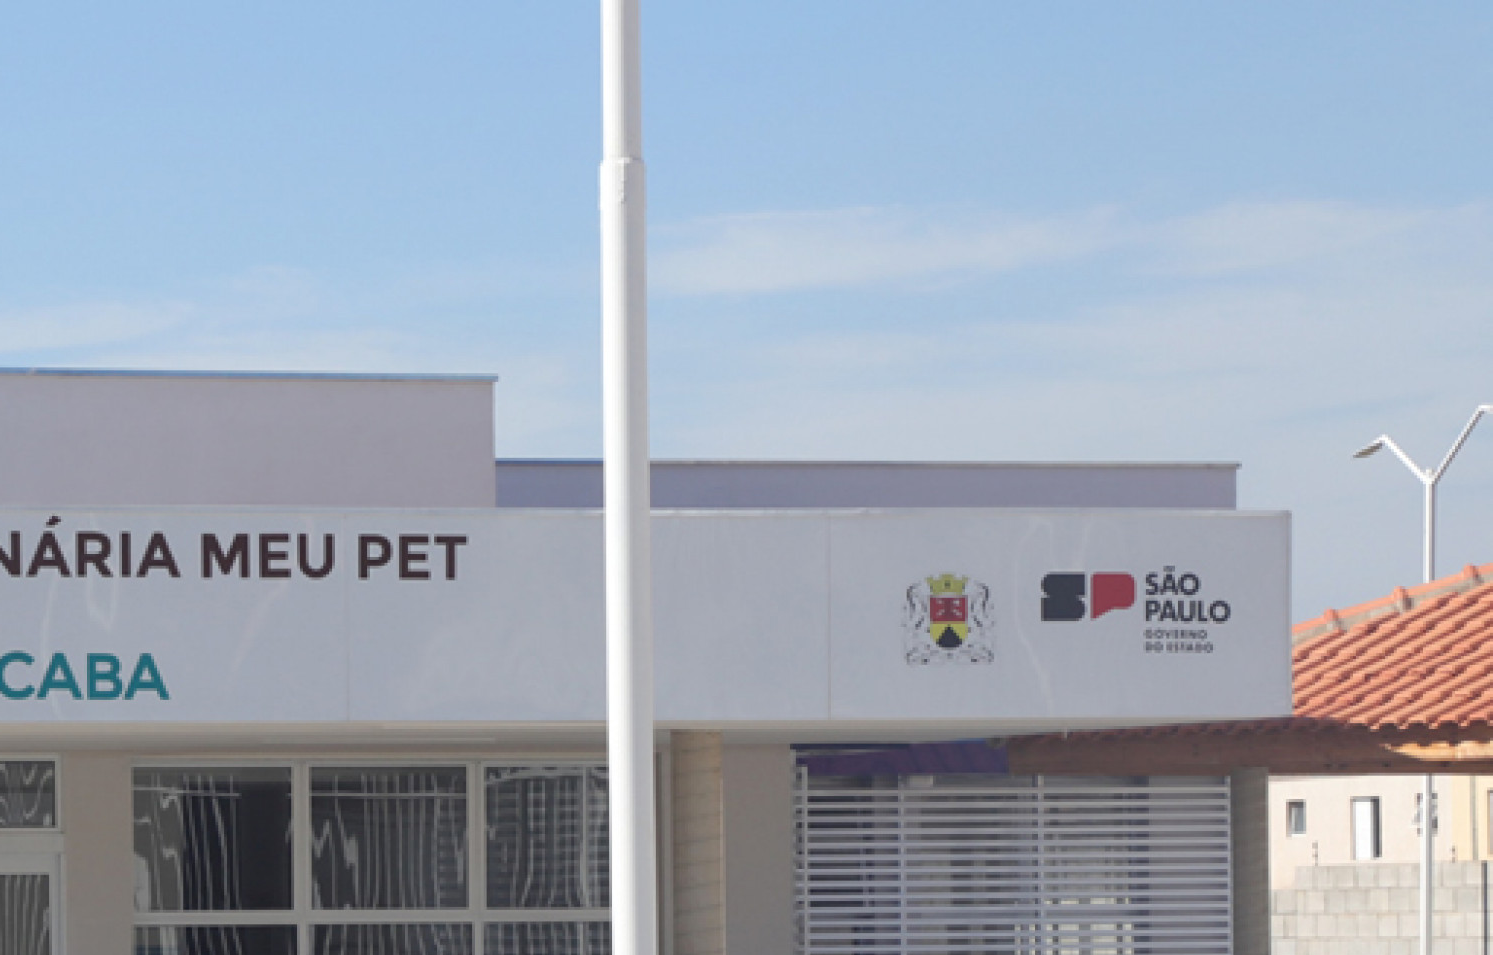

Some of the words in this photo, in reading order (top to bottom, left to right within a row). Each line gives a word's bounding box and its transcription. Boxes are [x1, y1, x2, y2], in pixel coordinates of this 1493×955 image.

[200, 532, 336, 579] MEU
[357, 533, 468, 580] PET
[1145, 565, 1201, 595] SÃO
[1145, 600, 1231, 622] PAULO
